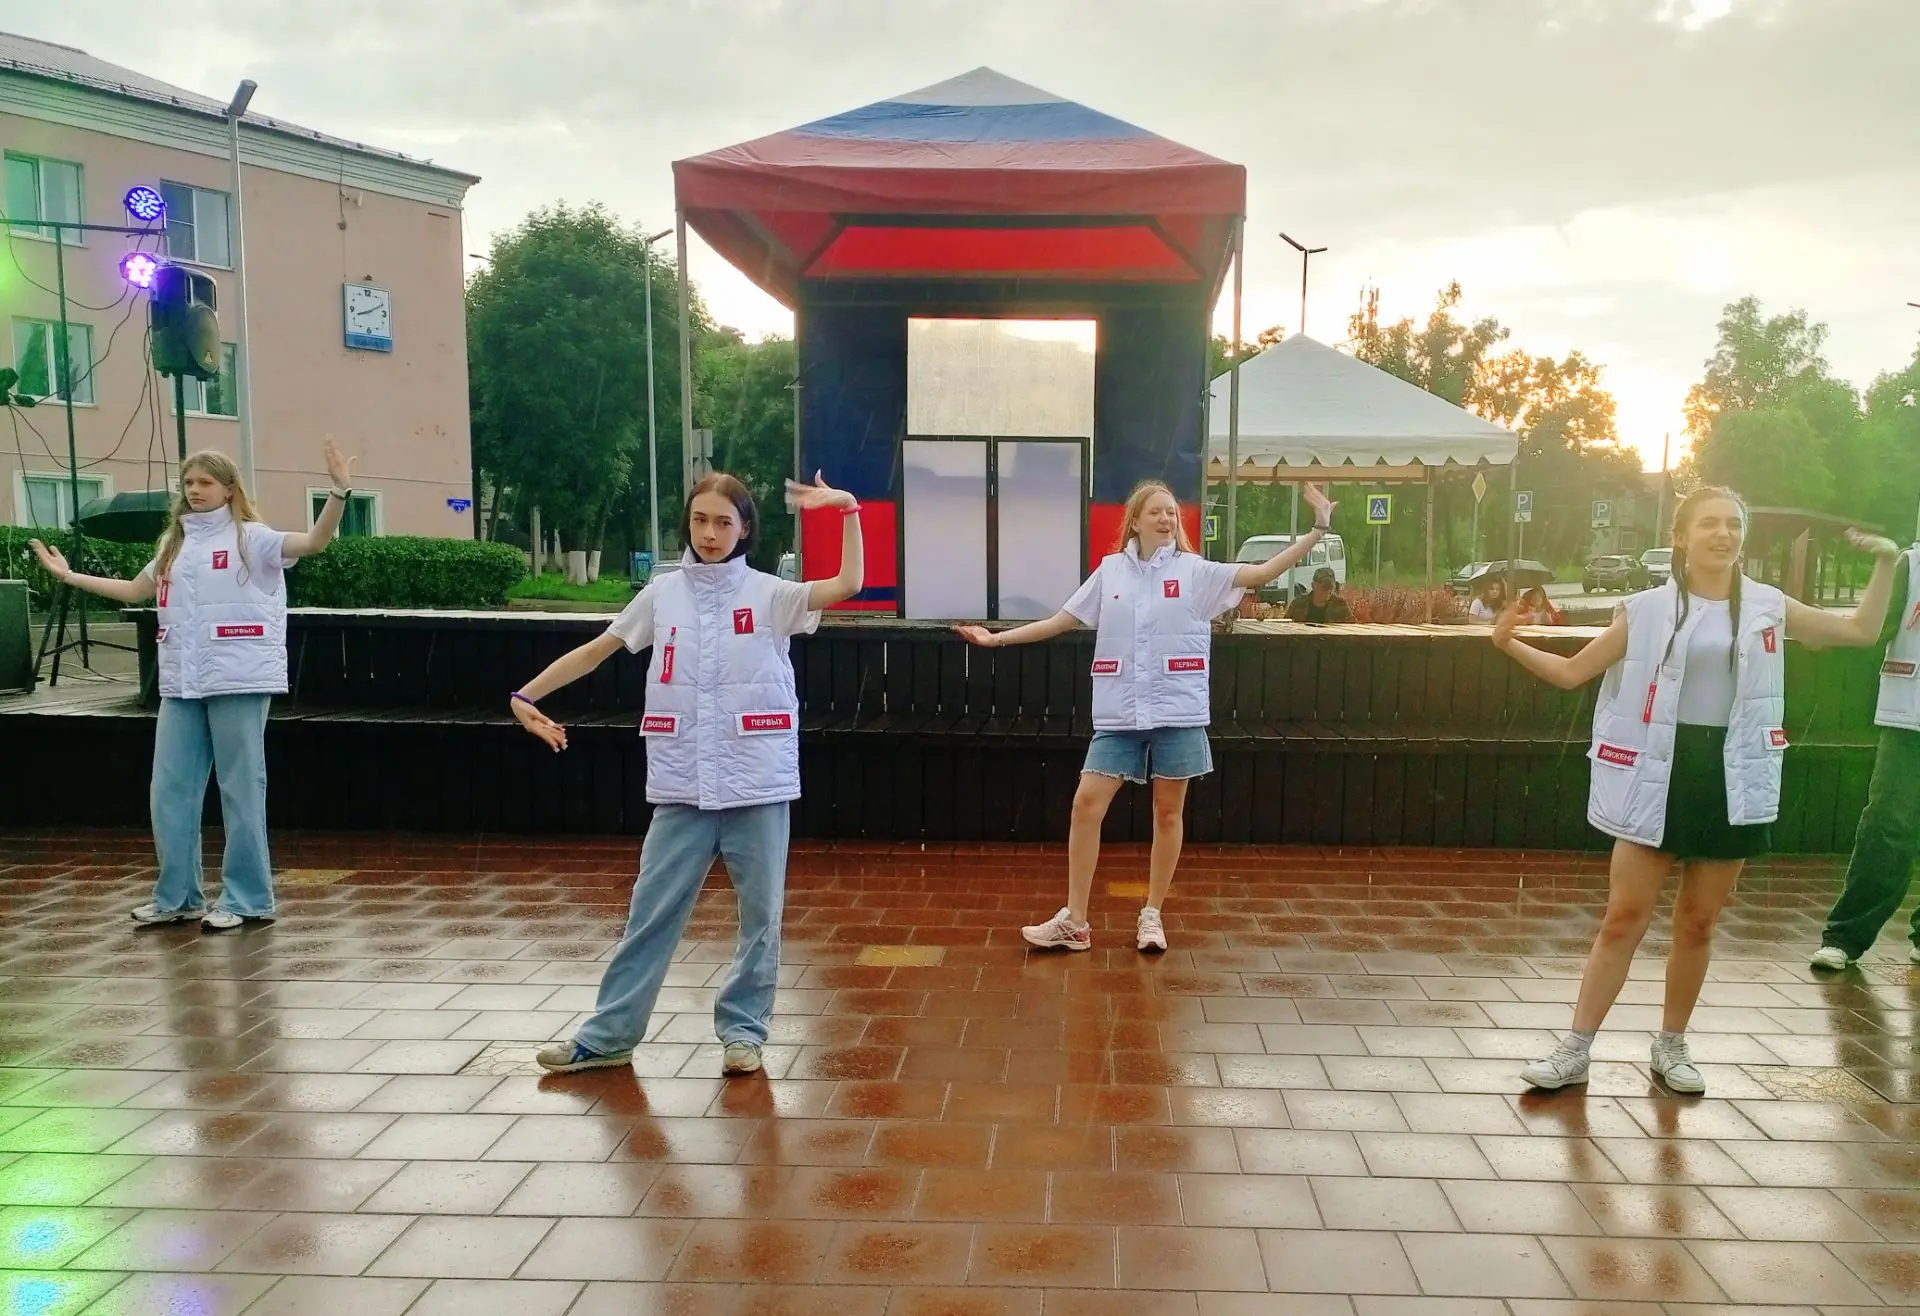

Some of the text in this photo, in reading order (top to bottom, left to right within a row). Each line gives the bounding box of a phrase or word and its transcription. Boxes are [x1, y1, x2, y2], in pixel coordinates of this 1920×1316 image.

[364, 289, 372, 297] 12
[381, 310, 387, 318] 3
[1517, 493, 1528, 510] P
[1597, 503, 1608, 517] P
[751, 718, 783, 726] ПЕРВЫХ
[1602, 748, 1635, 762] ДВИЖЕНИ
